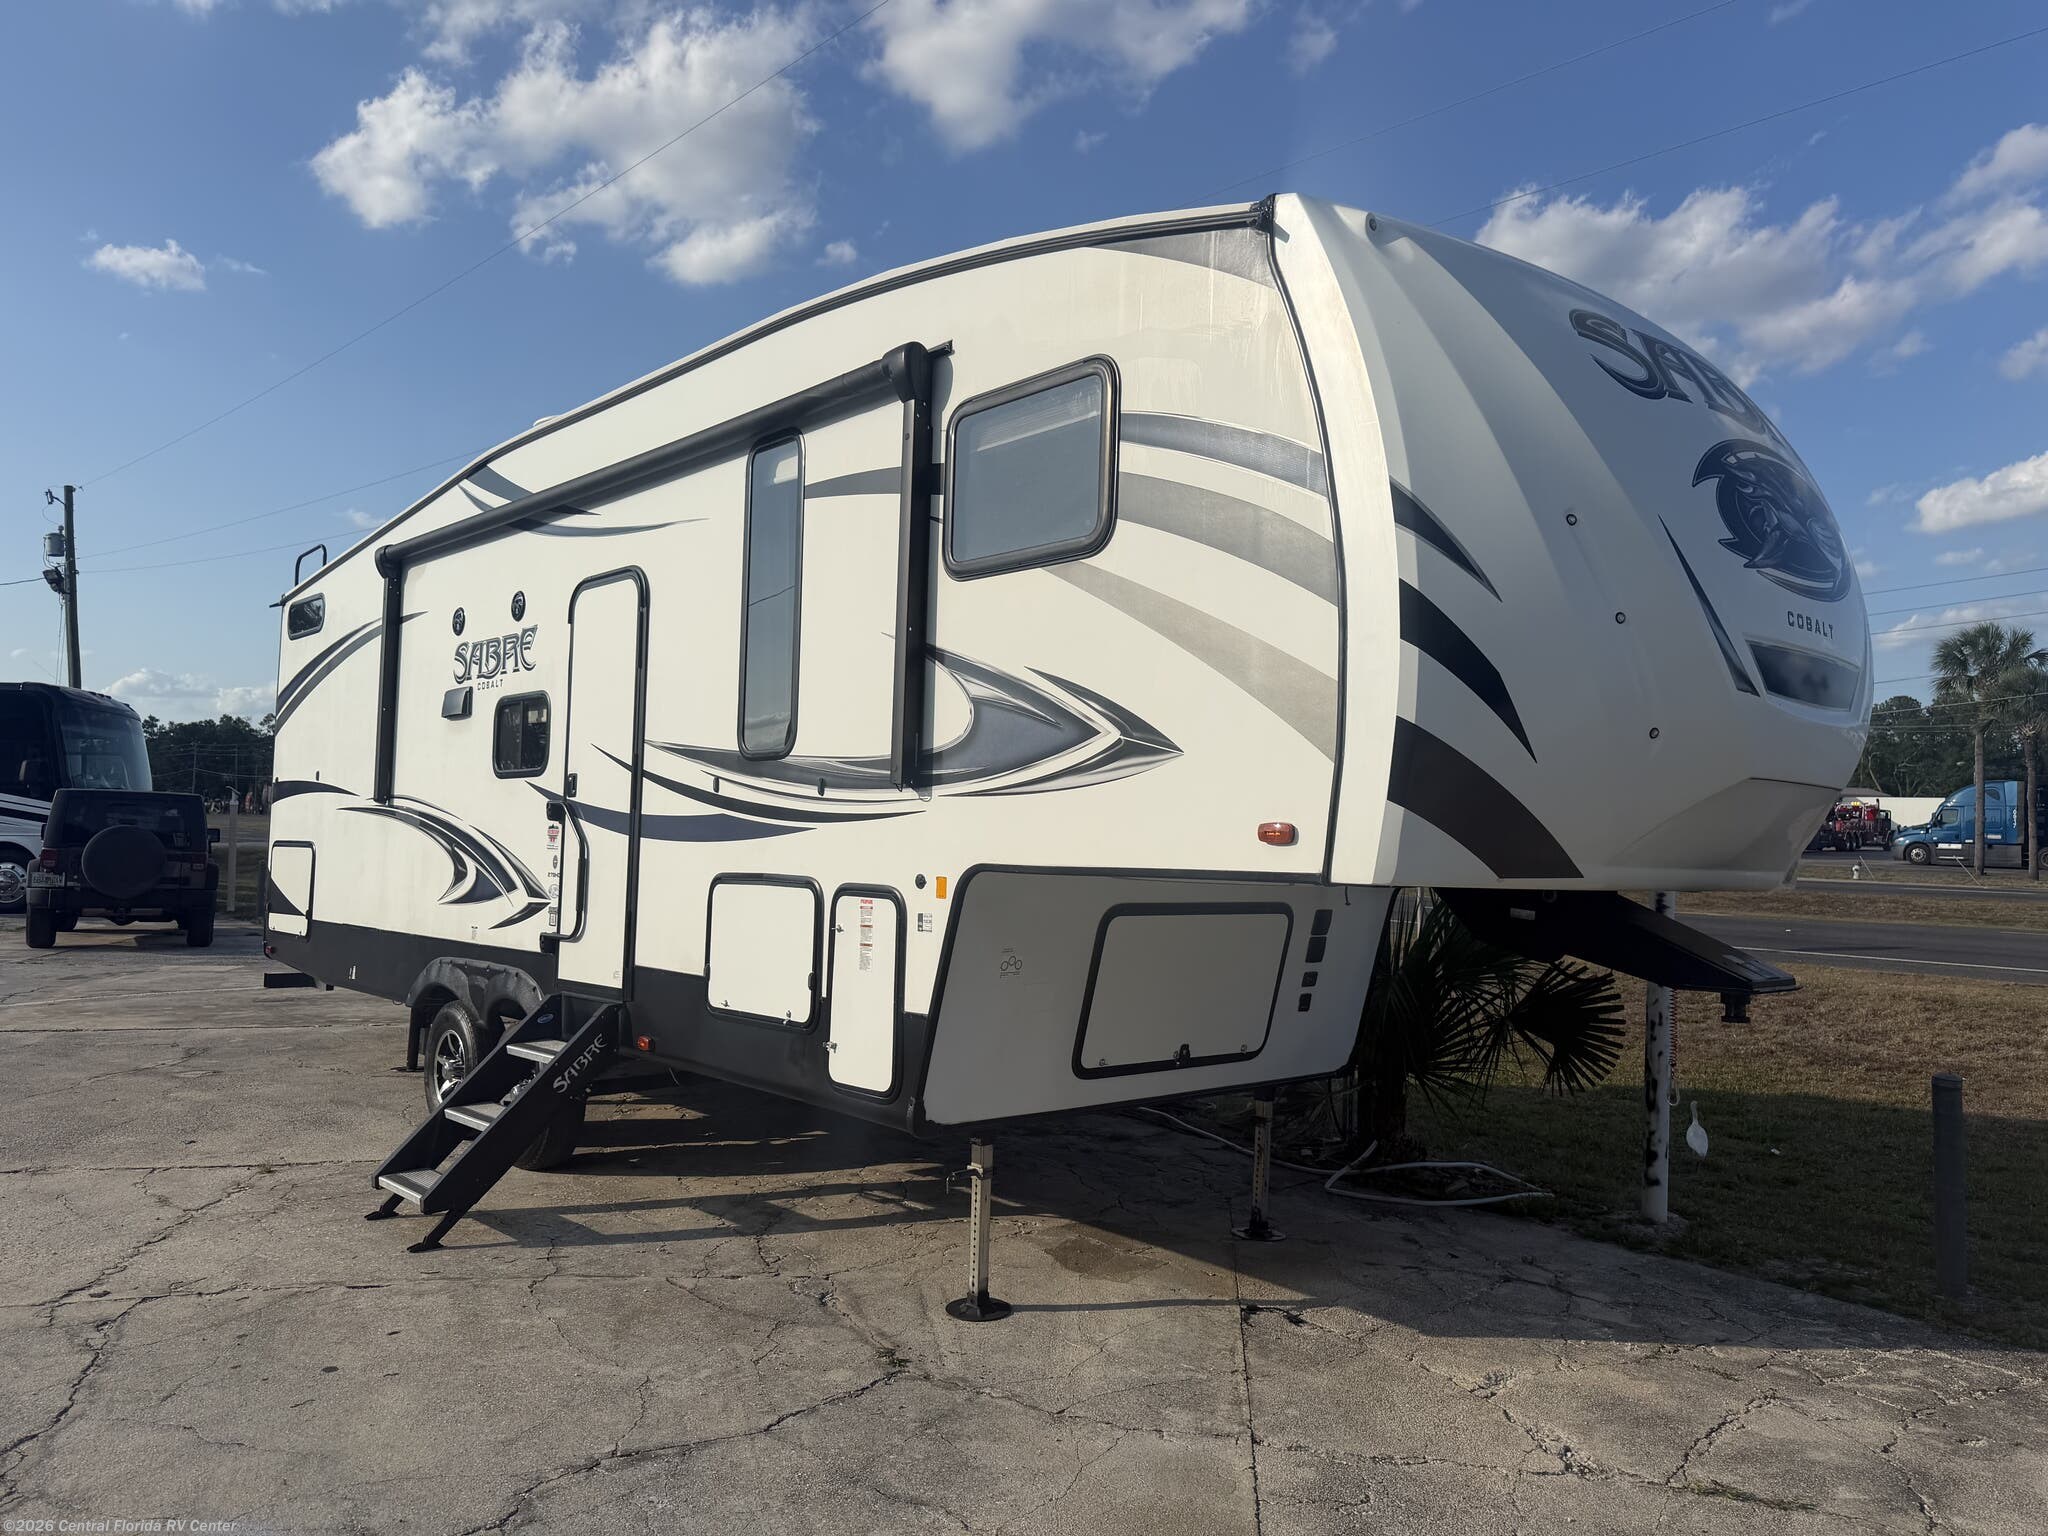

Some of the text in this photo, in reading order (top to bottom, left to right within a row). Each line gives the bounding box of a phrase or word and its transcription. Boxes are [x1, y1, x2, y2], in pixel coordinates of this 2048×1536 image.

[1787, 610, 1834, 640] COBALT
[453, 624, 538, 684] SABRE
[477, 679, 503, 690] COBALT
[553, 1033, 608, 1093] SABRE
